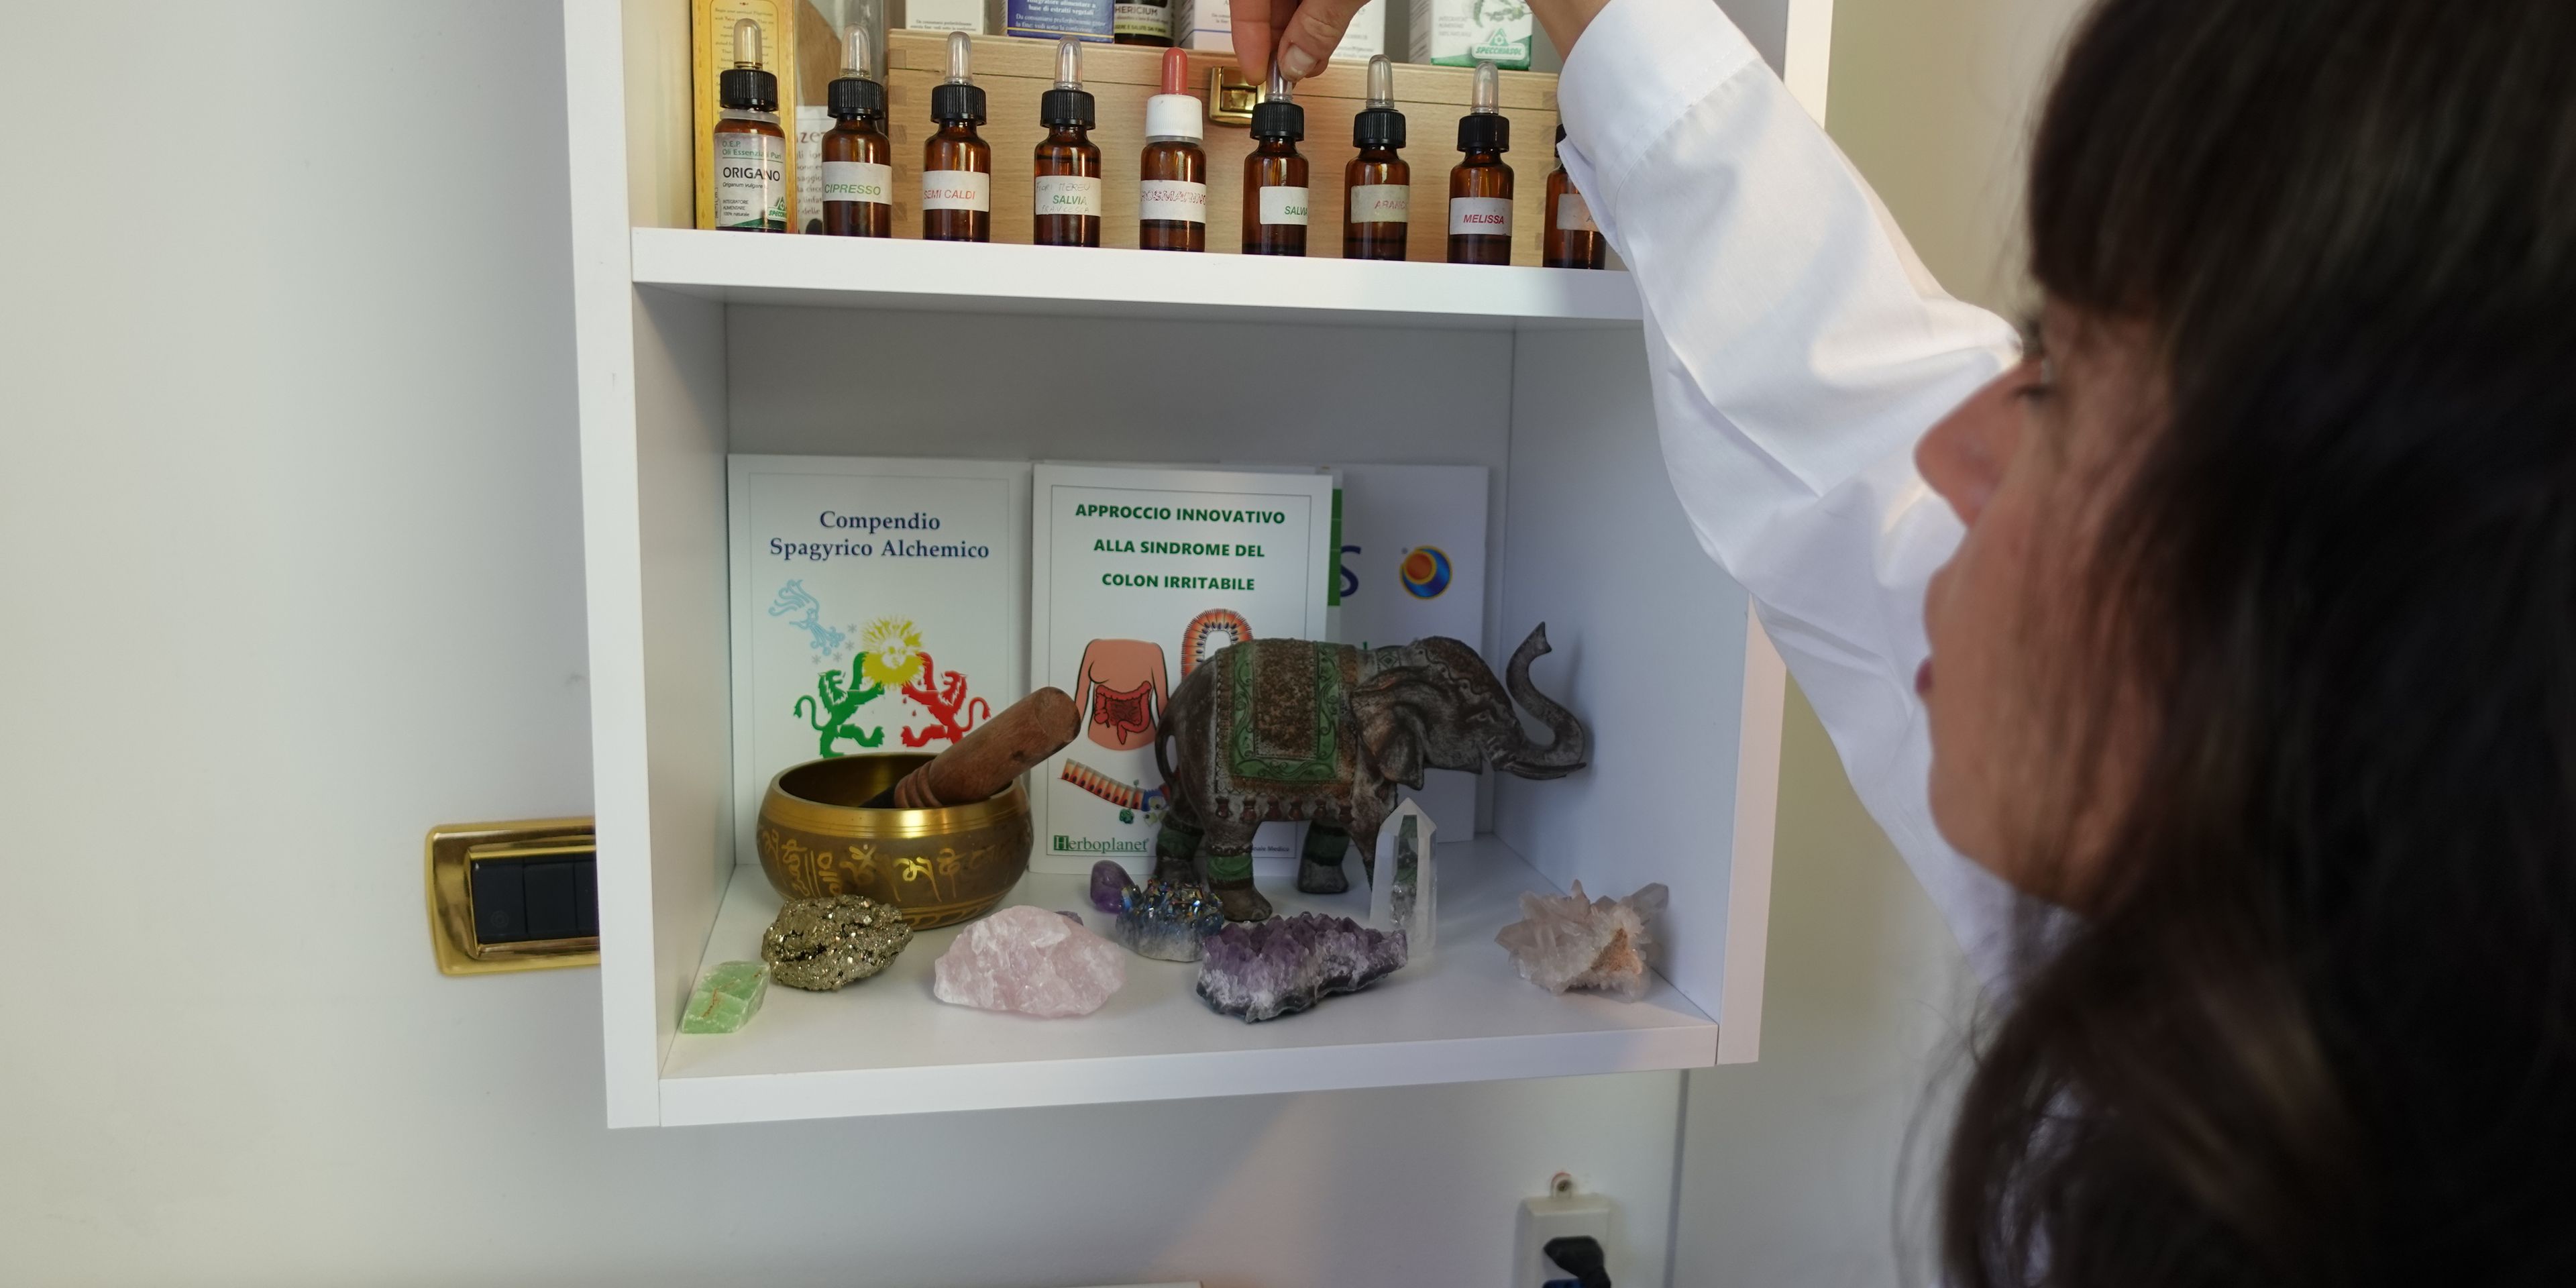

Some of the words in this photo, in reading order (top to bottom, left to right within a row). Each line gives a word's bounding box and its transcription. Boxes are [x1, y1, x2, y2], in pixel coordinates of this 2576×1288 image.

[1115, 5, 1159, 16] HERICIUM
[733, 150, 769, 158] Essenziai
[722, 167, 781, 182] ORIGANO
[824, 184, 881, 195] CIPRESSO
[924, 189, 941, 199] SEMI
[944, 190, 975, 199] CALDI
[1053, 195, 1087, 205] SALVIA
[1463, 214, 1505, 225] MELISSA
[1075, 504, 1171, 520] APPROCCIO
[1176, 508, 1285, 524] INNOVATIVO
[820, 511, 941, 535] Compendio
[770, 537, 872, 561] Spagyrico
[881, 539, 989, 558] Alchemico
[1093, 539, 1135, 553] ALLA
[1140, 541, 1230, 556] SINDROME
[1235, 544, 1265, 557] DEL
[1102, 573, 1159, 588] COLON
[1164, 576, 1255, 591] IRRITABILE
